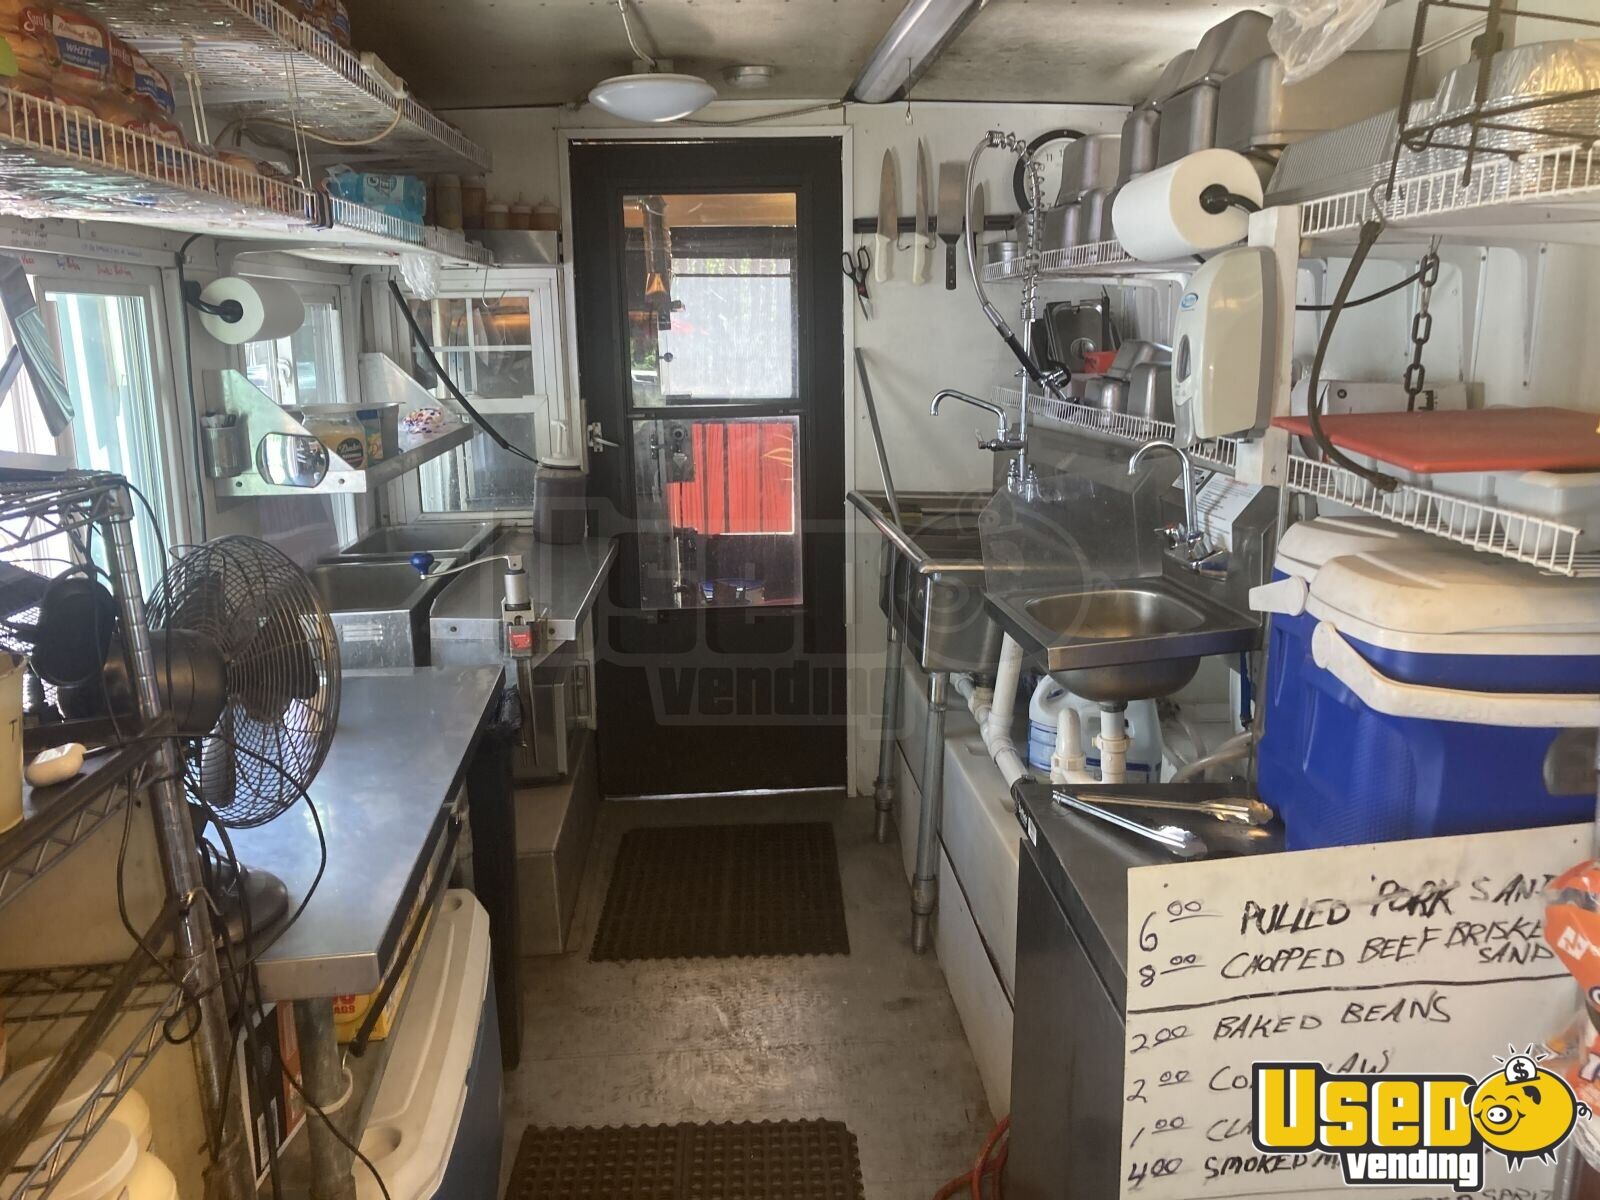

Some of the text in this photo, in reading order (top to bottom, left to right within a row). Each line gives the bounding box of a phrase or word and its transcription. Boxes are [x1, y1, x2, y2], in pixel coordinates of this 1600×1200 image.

[1240, 899, 1351, 935] PULLED
[1370, 879, 1461, 918] PORK
[1220, 946, 1345, 979] CHOPPED
[1357, 926, 1443, 964] BEEF
[1478, 941, 1556, 965] SAND
[1212, 1013, 1323, 1041] BAKED
[1340, 989, 1452, 1024] BEANS
[1204, 1153, 1309, 1180] SMOKED
